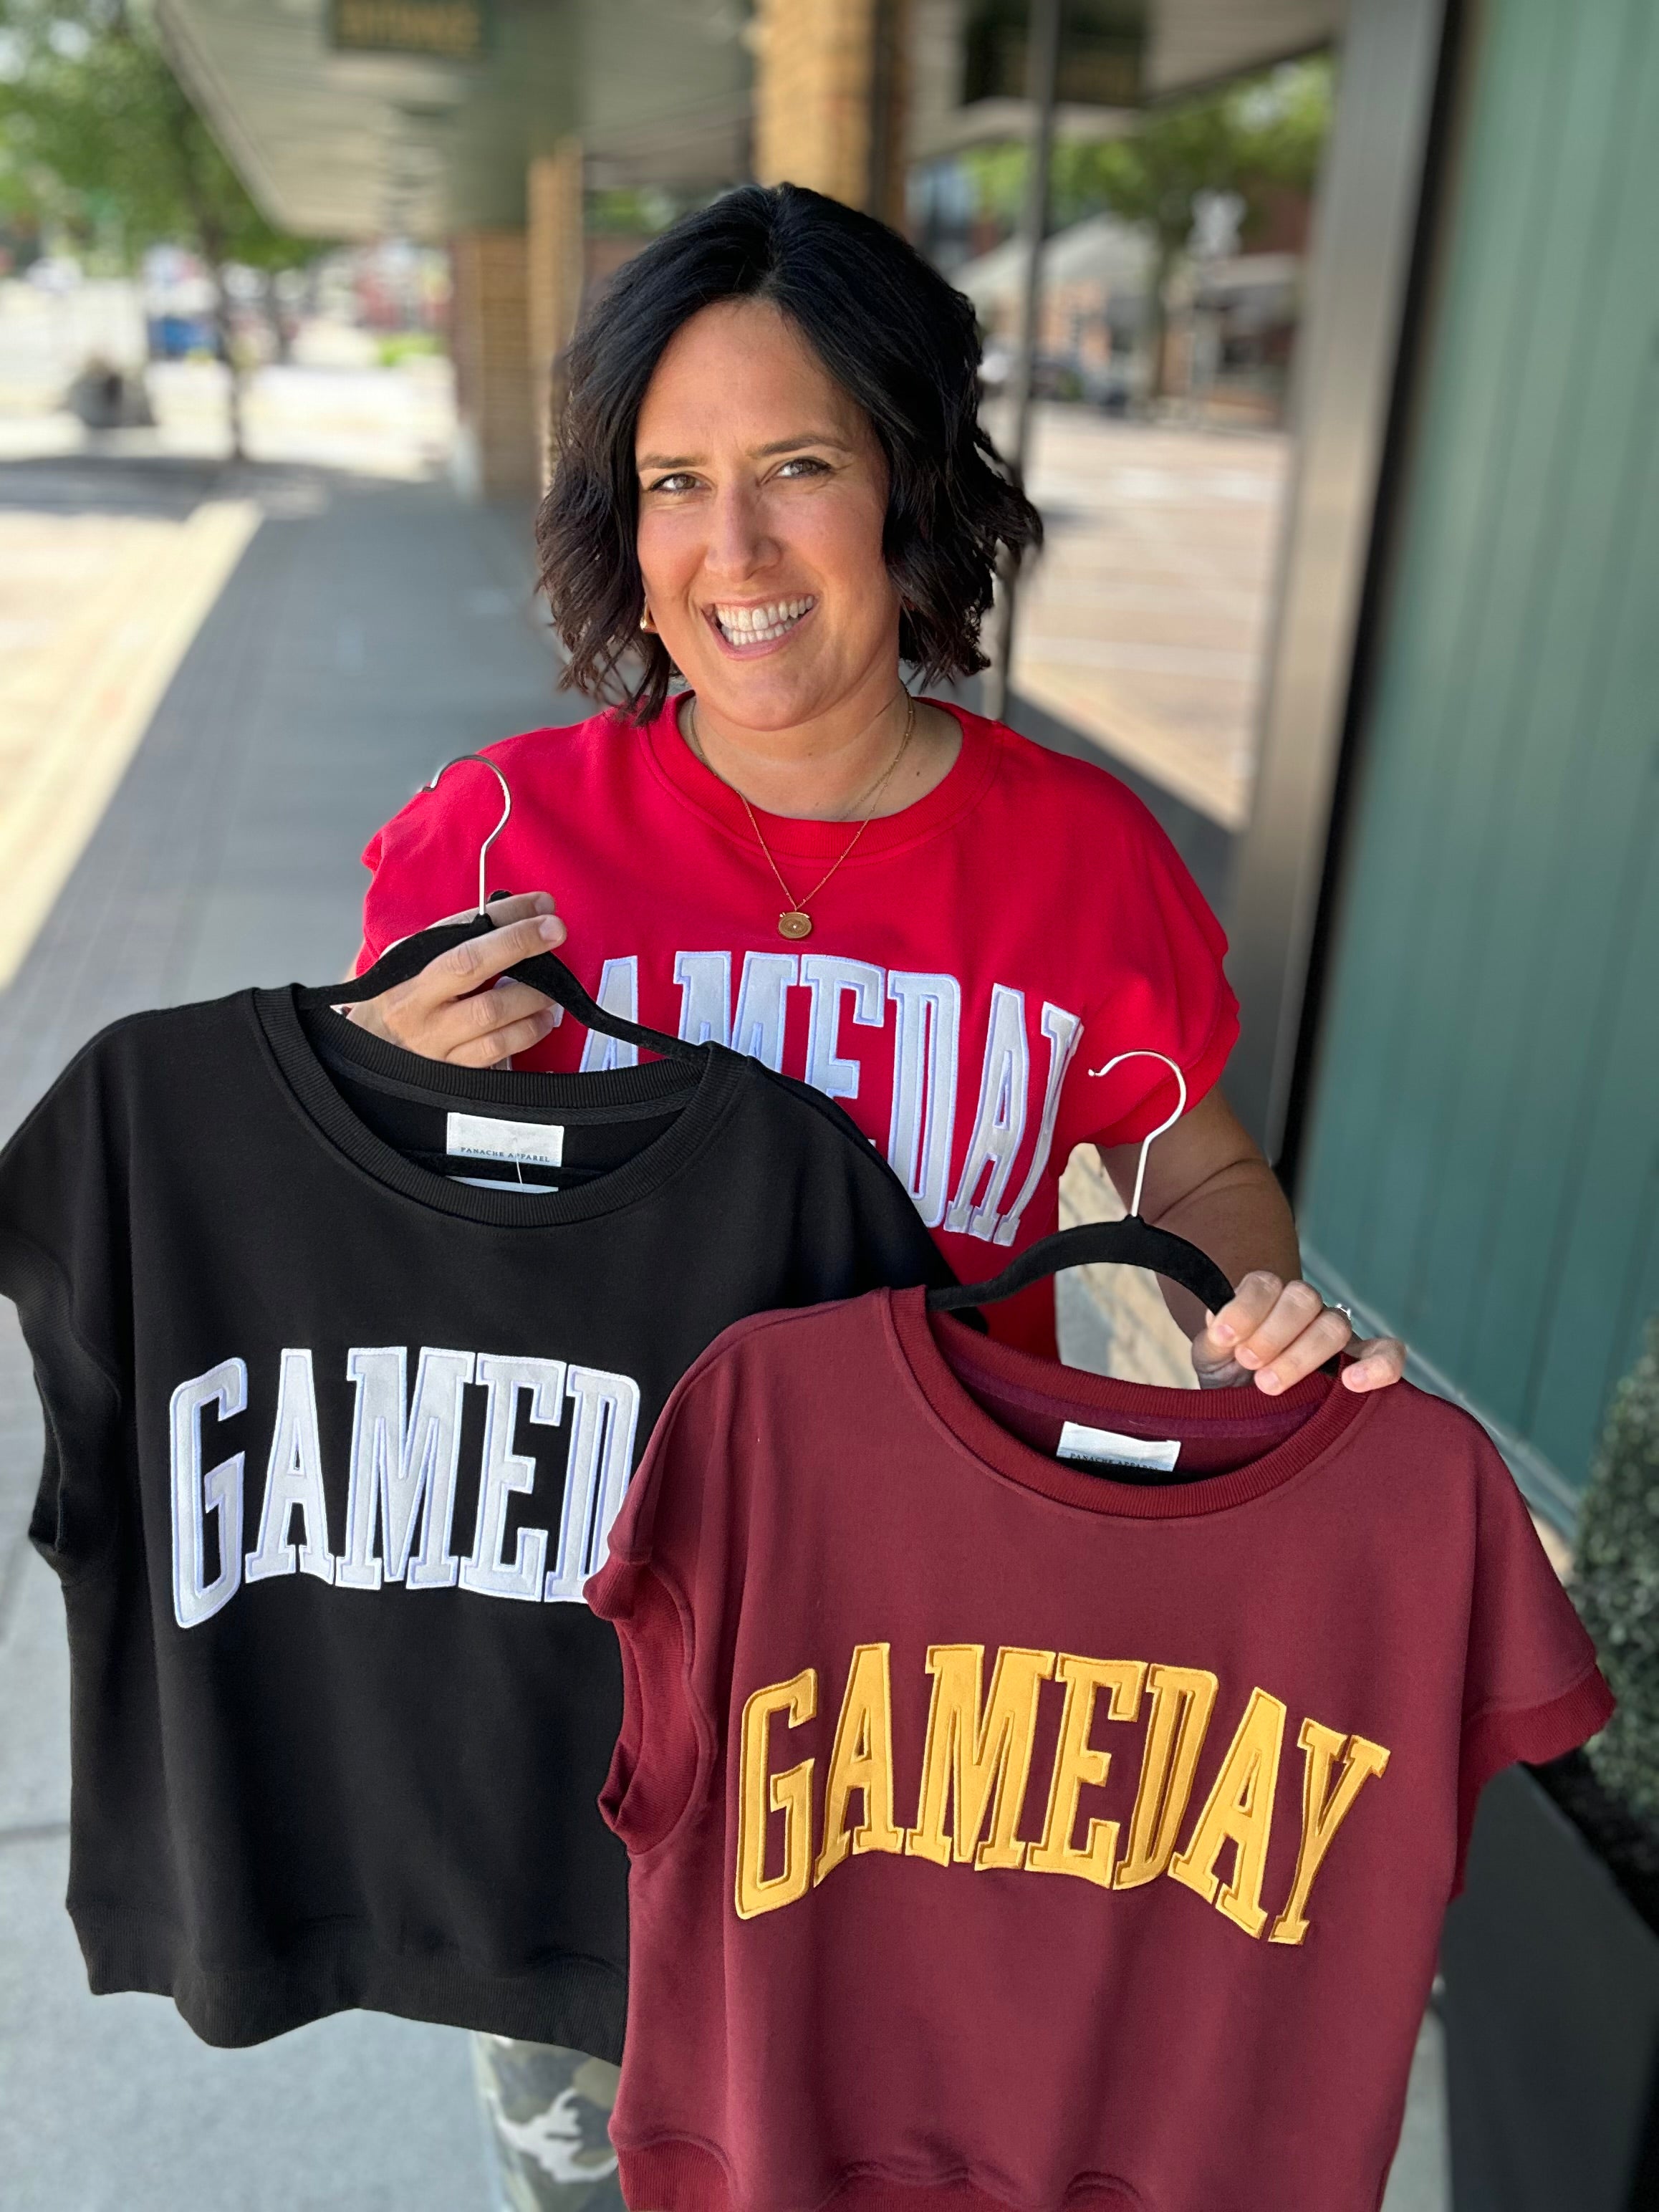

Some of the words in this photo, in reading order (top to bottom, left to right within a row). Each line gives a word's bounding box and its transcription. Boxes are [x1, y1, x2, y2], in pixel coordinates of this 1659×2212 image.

[461, 1147, 504, 1157] PANACHE
[493, 951, 1085, 1246] EDAY
[170, 1347, 640, 1629] GAMED
[734, 1642, 1390, 1946] GAMEDAY
